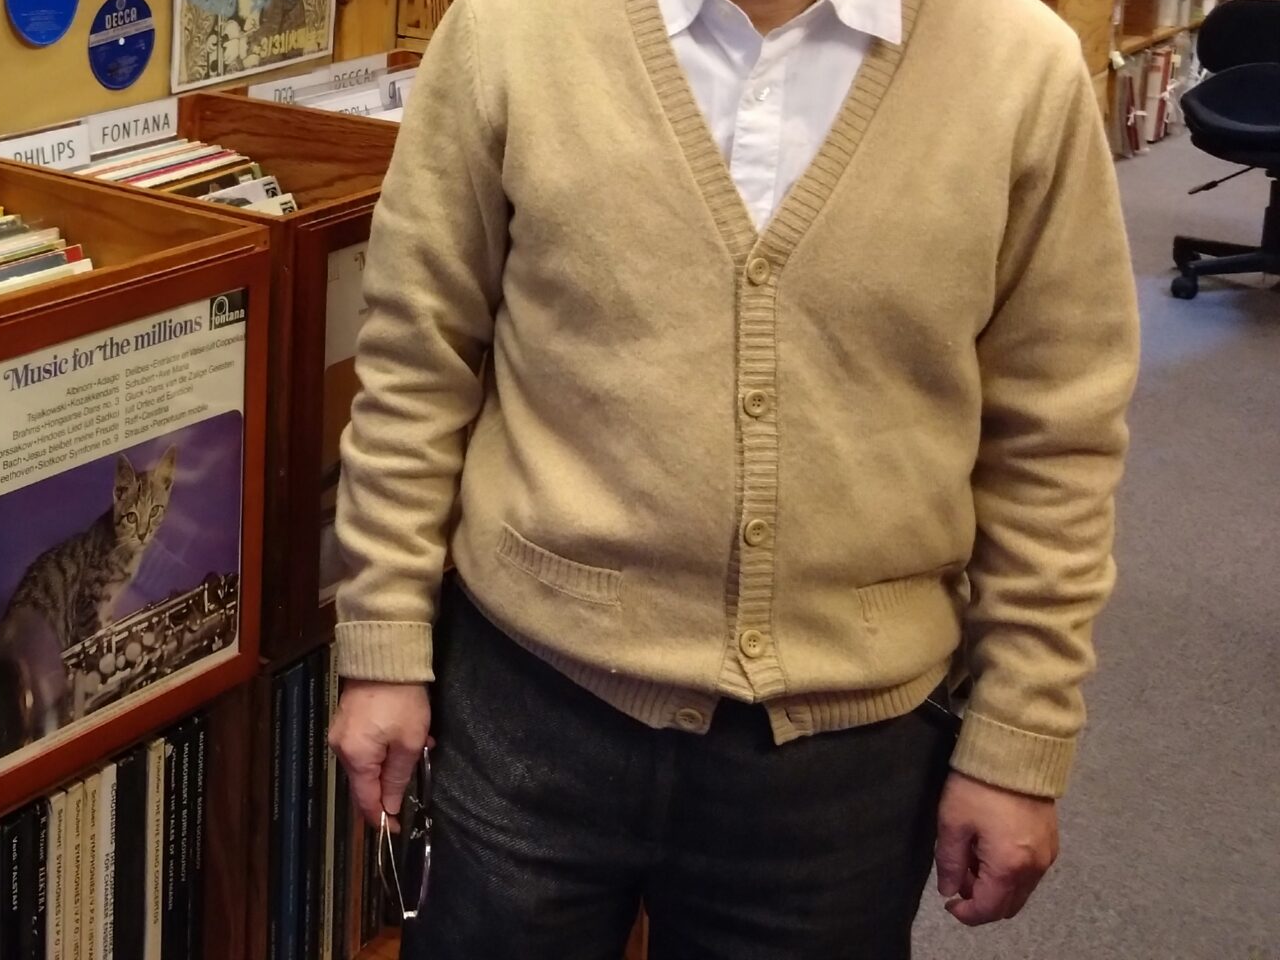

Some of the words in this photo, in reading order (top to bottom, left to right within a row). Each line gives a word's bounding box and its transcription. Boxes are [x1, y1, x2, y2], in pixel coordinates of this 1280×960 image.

[105, 7, 138, 30] DECCA
[101, 111, 172, 145] FONTANA
[211, 295, 247, 331] fontana
[3, 353, 70, 392] Music
[71, 344, 104, 372] for
[102, 336, 132, 362] the
[133, 313, 203, 353] millions
